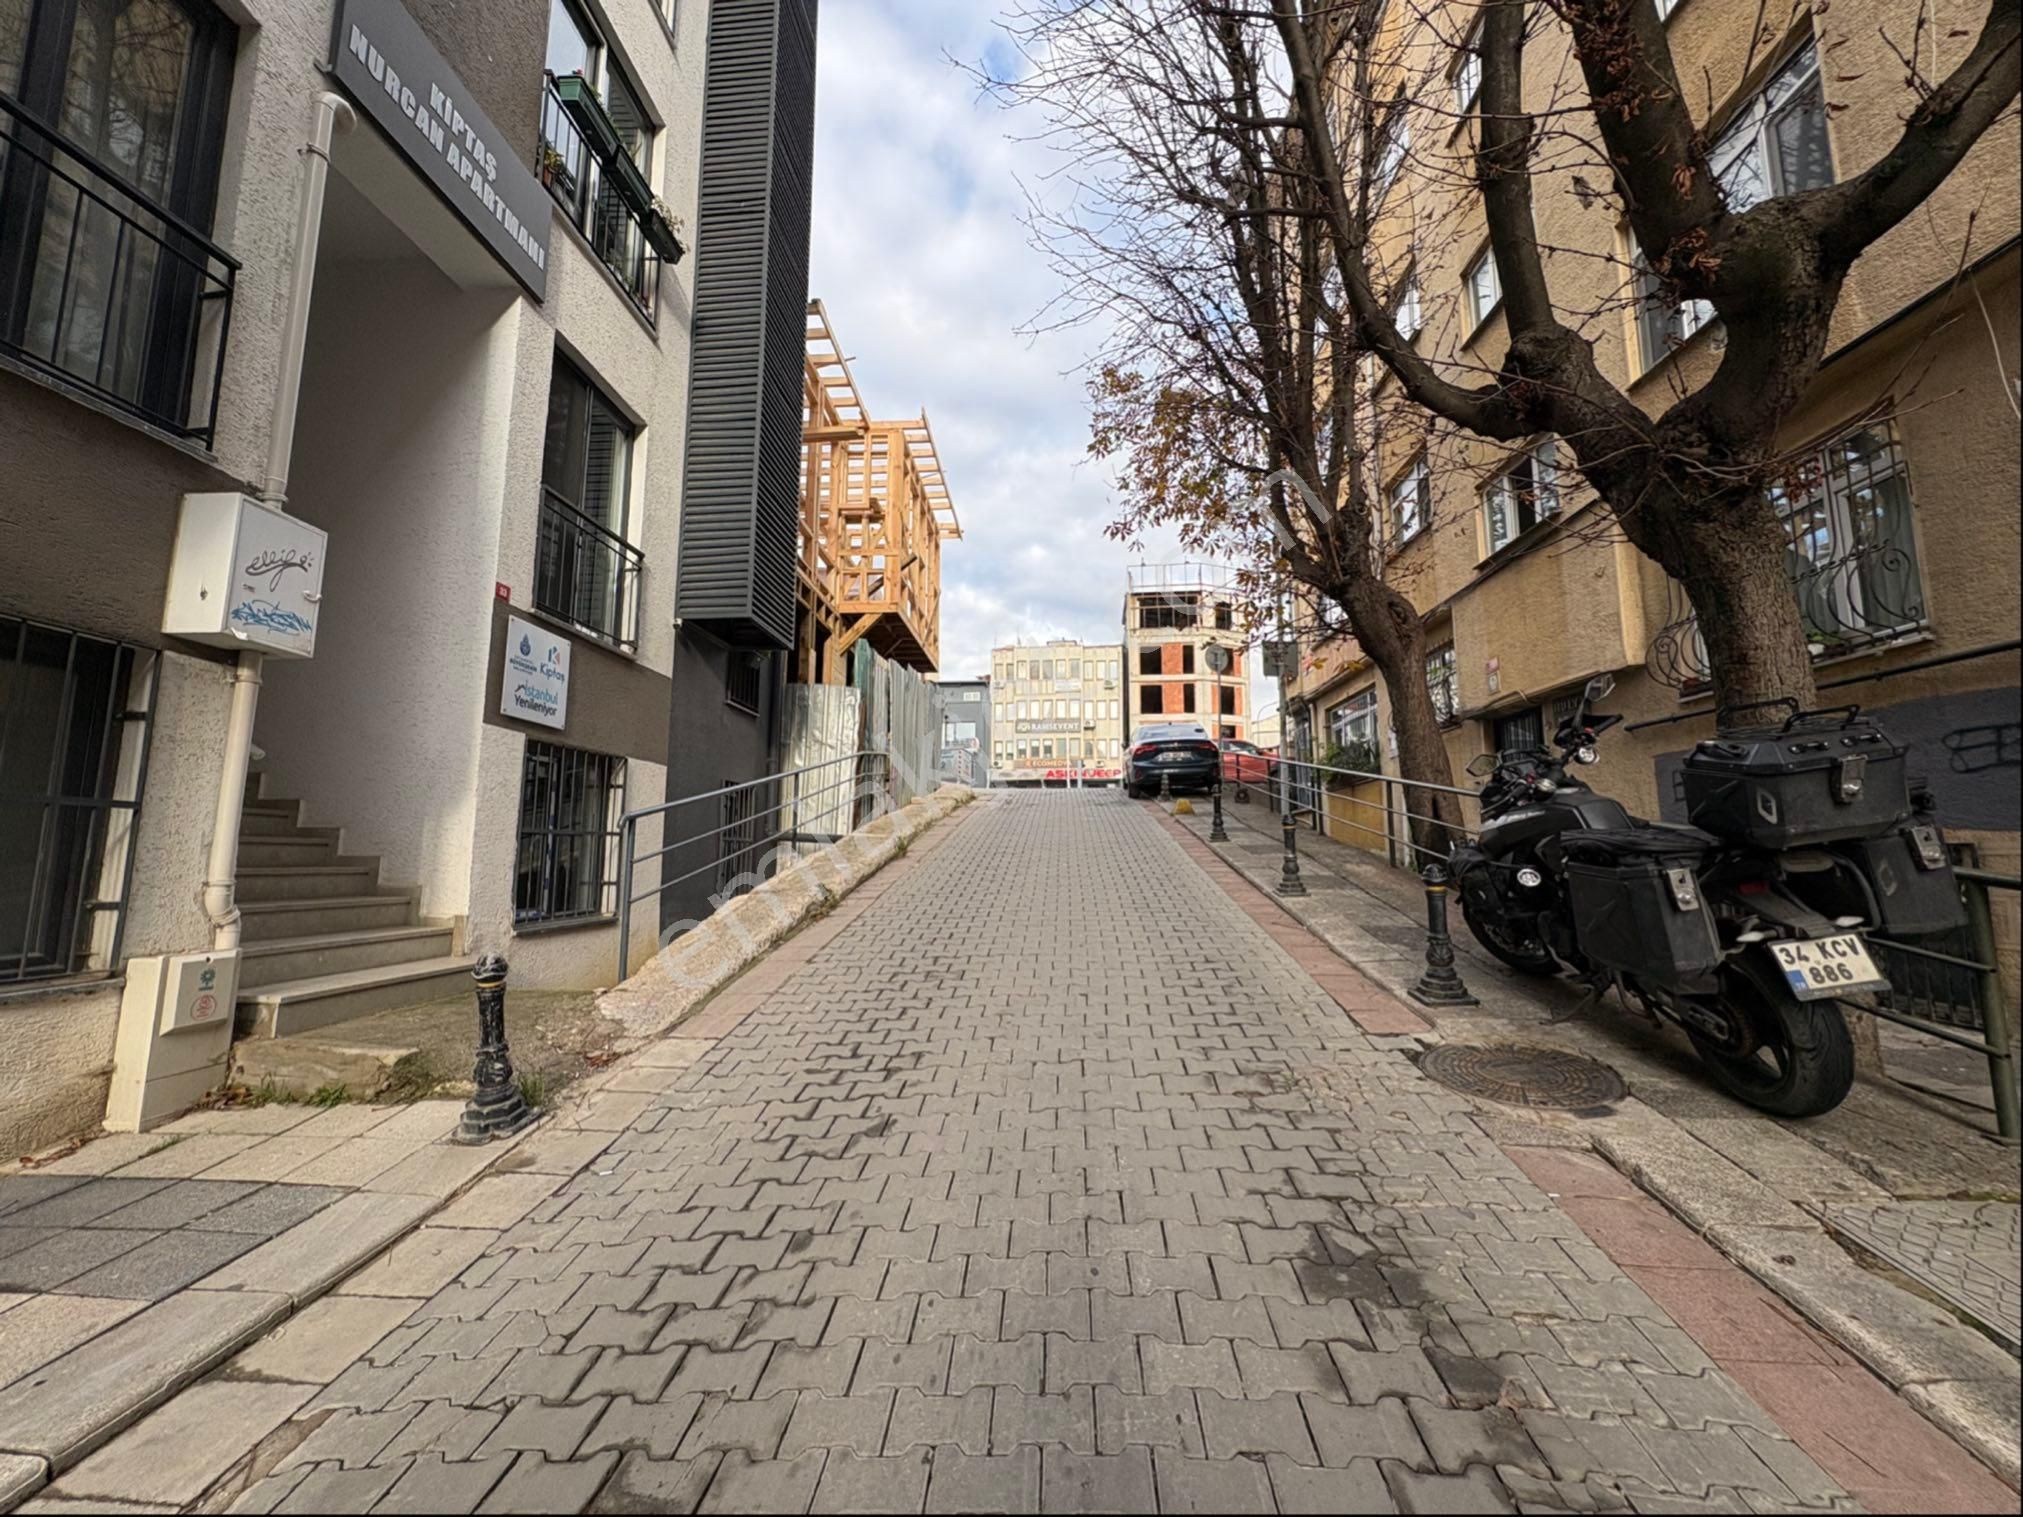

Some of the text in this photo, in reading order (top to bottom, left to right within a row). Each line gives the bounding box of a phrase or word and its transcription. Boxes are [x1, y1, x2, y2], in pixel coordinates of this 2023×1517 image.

[350, 24, 545, 271] NURCAN APARTMANI
[514, 694, 557, 717] Yenileniyor
[1779, 937, 1860, 965] 34 KCV
[1808, 962, 1853, 984] 886
